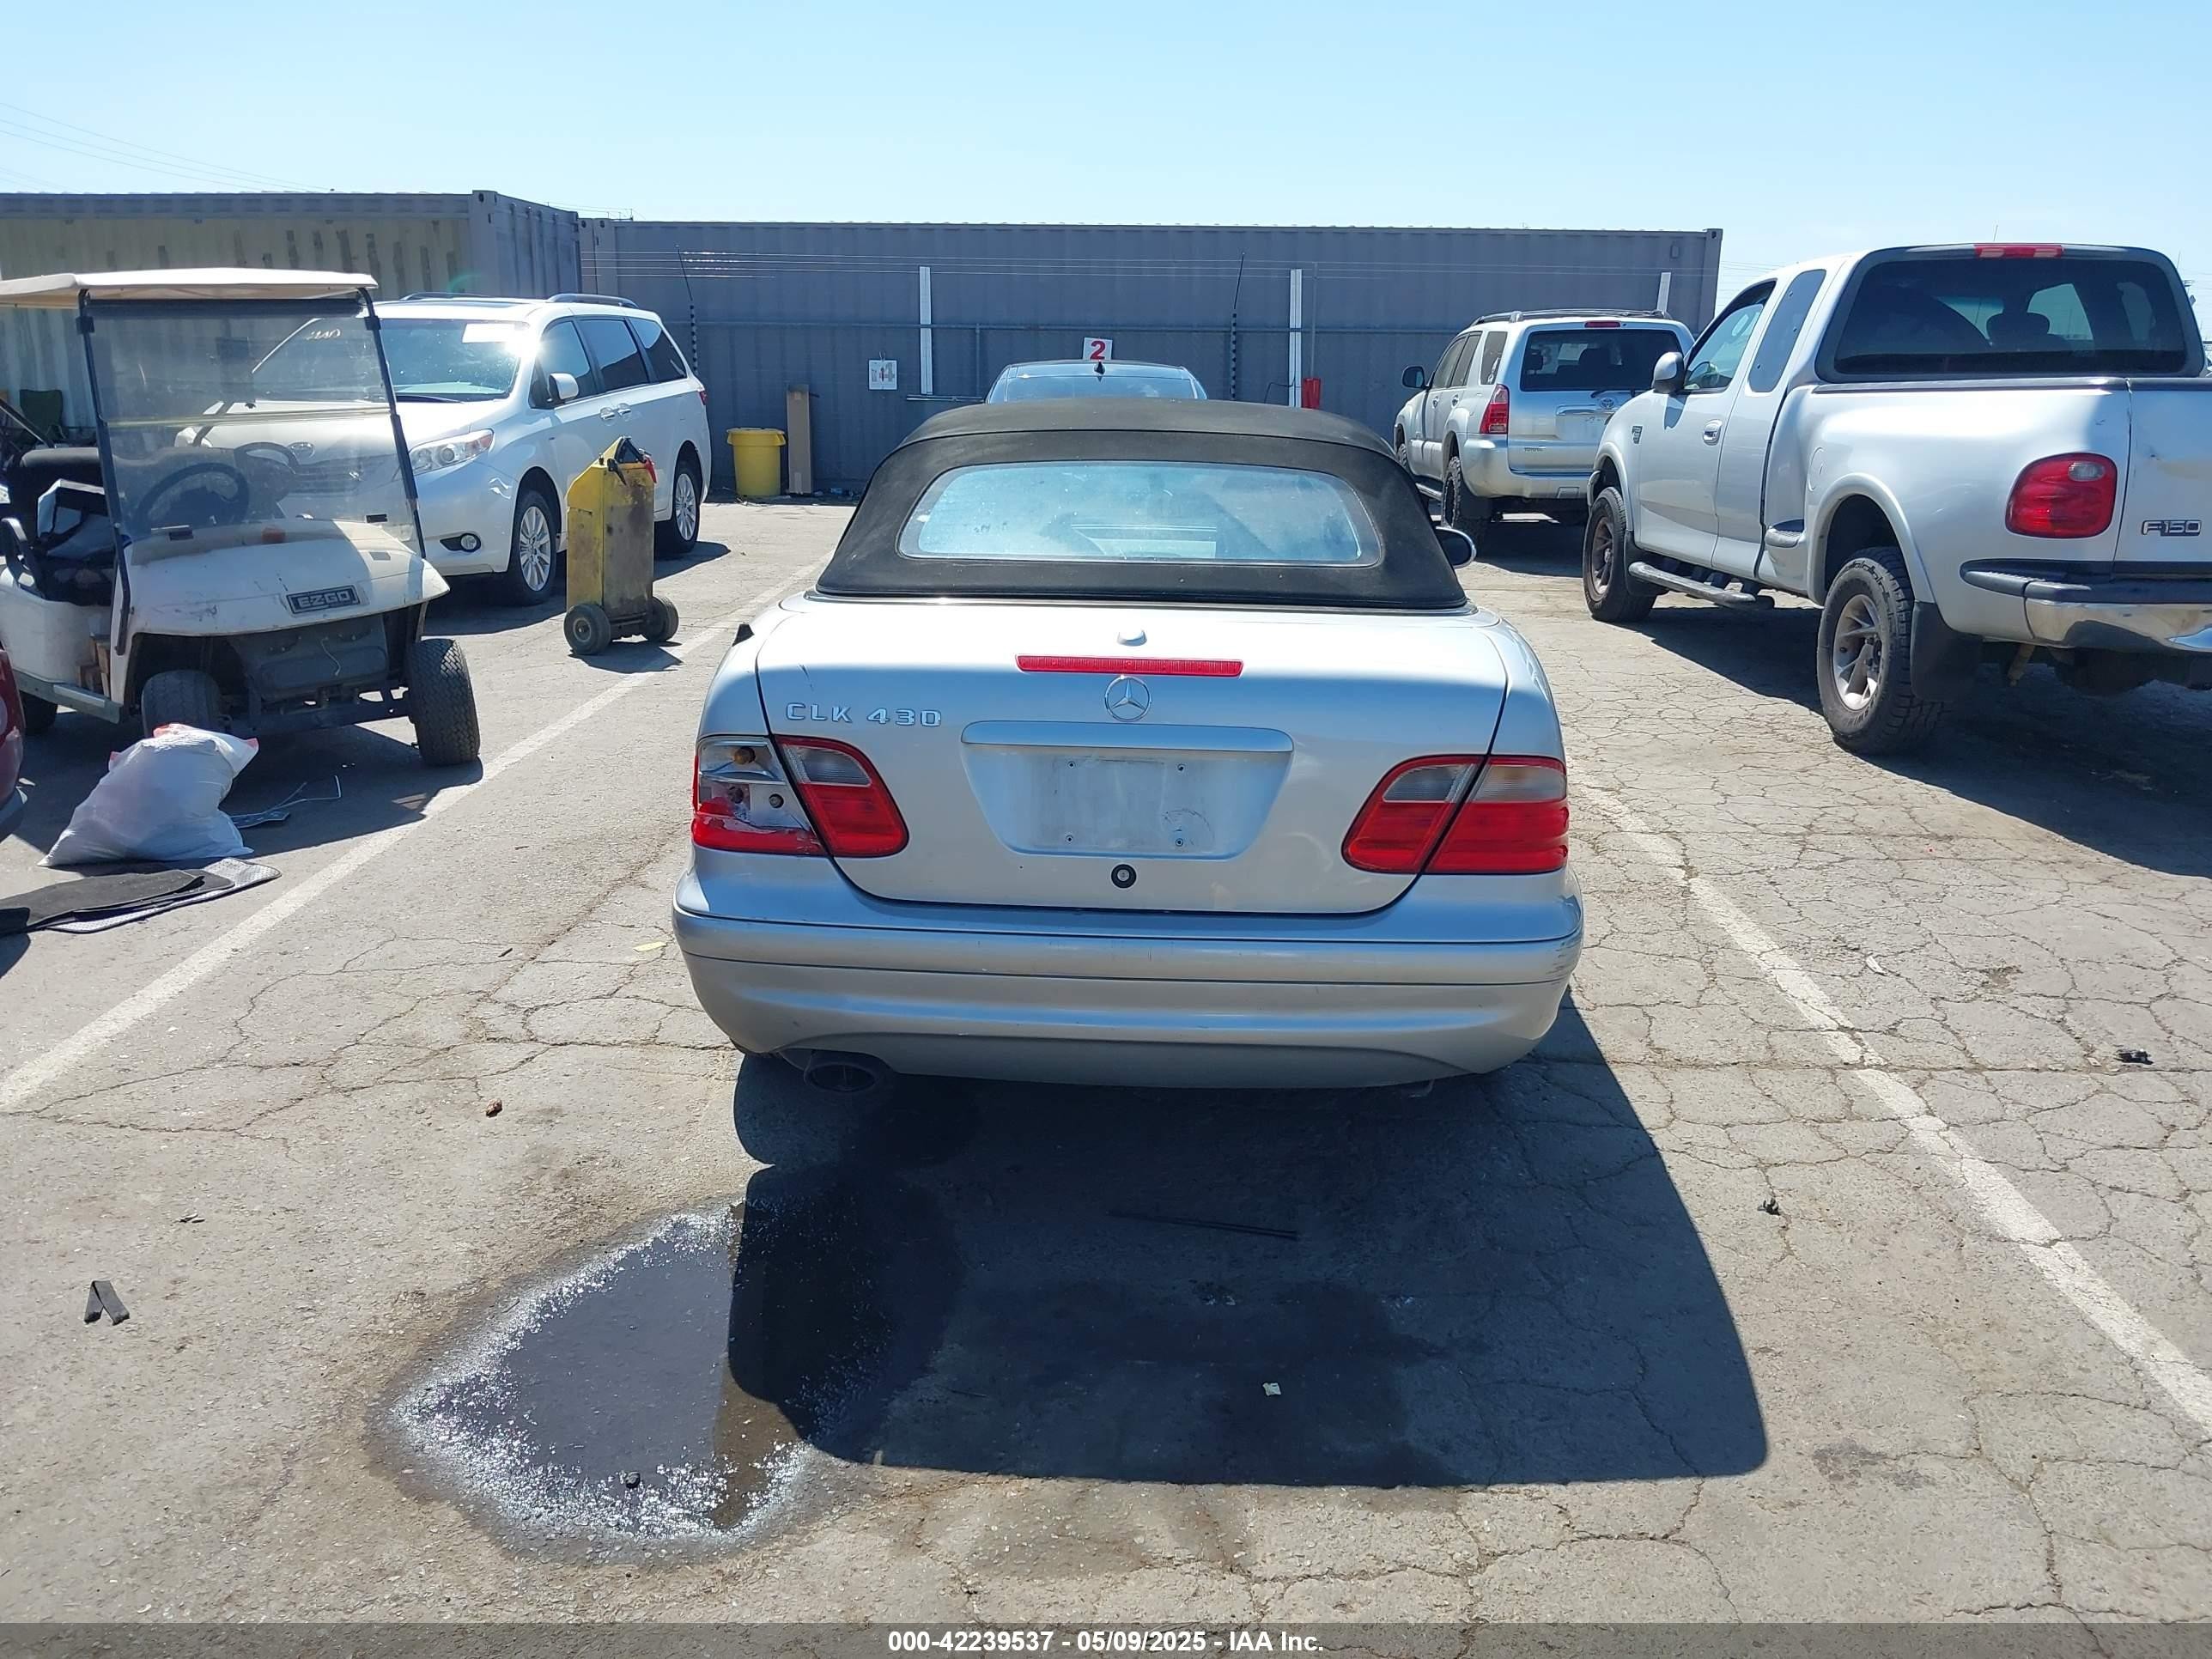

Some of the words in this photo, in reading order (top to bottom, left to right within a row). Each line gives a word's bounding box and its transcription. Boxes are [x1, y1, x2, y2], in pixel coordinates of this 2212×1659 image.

[1090, 340, 1106, 360] 2
[786, 702, 853, 724] CLK
[866, 708, 942, 727] 430
